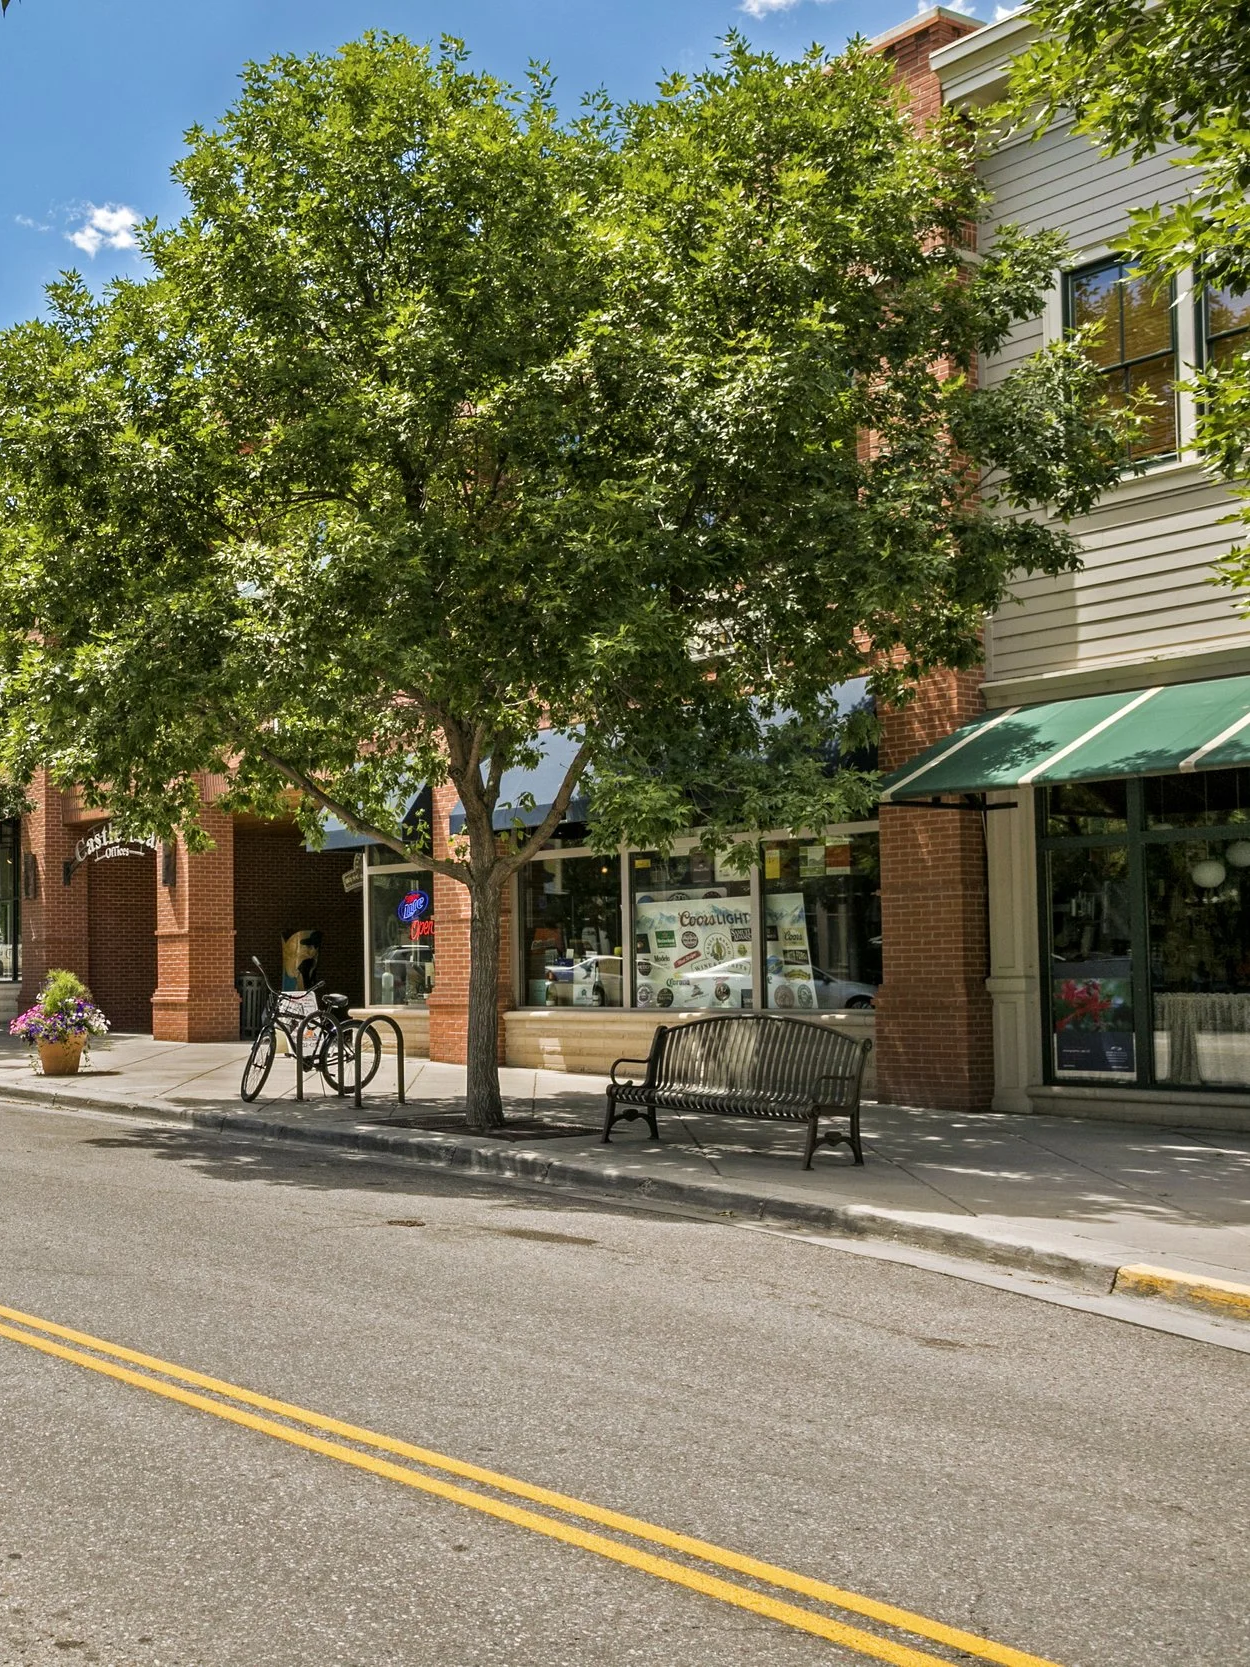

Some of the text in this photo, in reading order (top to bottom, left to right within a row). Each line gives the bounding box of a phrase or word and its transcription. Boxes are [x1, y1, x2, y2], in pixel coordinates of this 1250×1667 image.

[105, 845, 130, 859] Offices
[678, 910, 749, 927] Coors LIGHT
[410, 920, 435, 941] Open
[654, 954, 670, 962] Modelo
[694, 962, 712, 971] WINE
[666, 978, 691, 988] Corona
